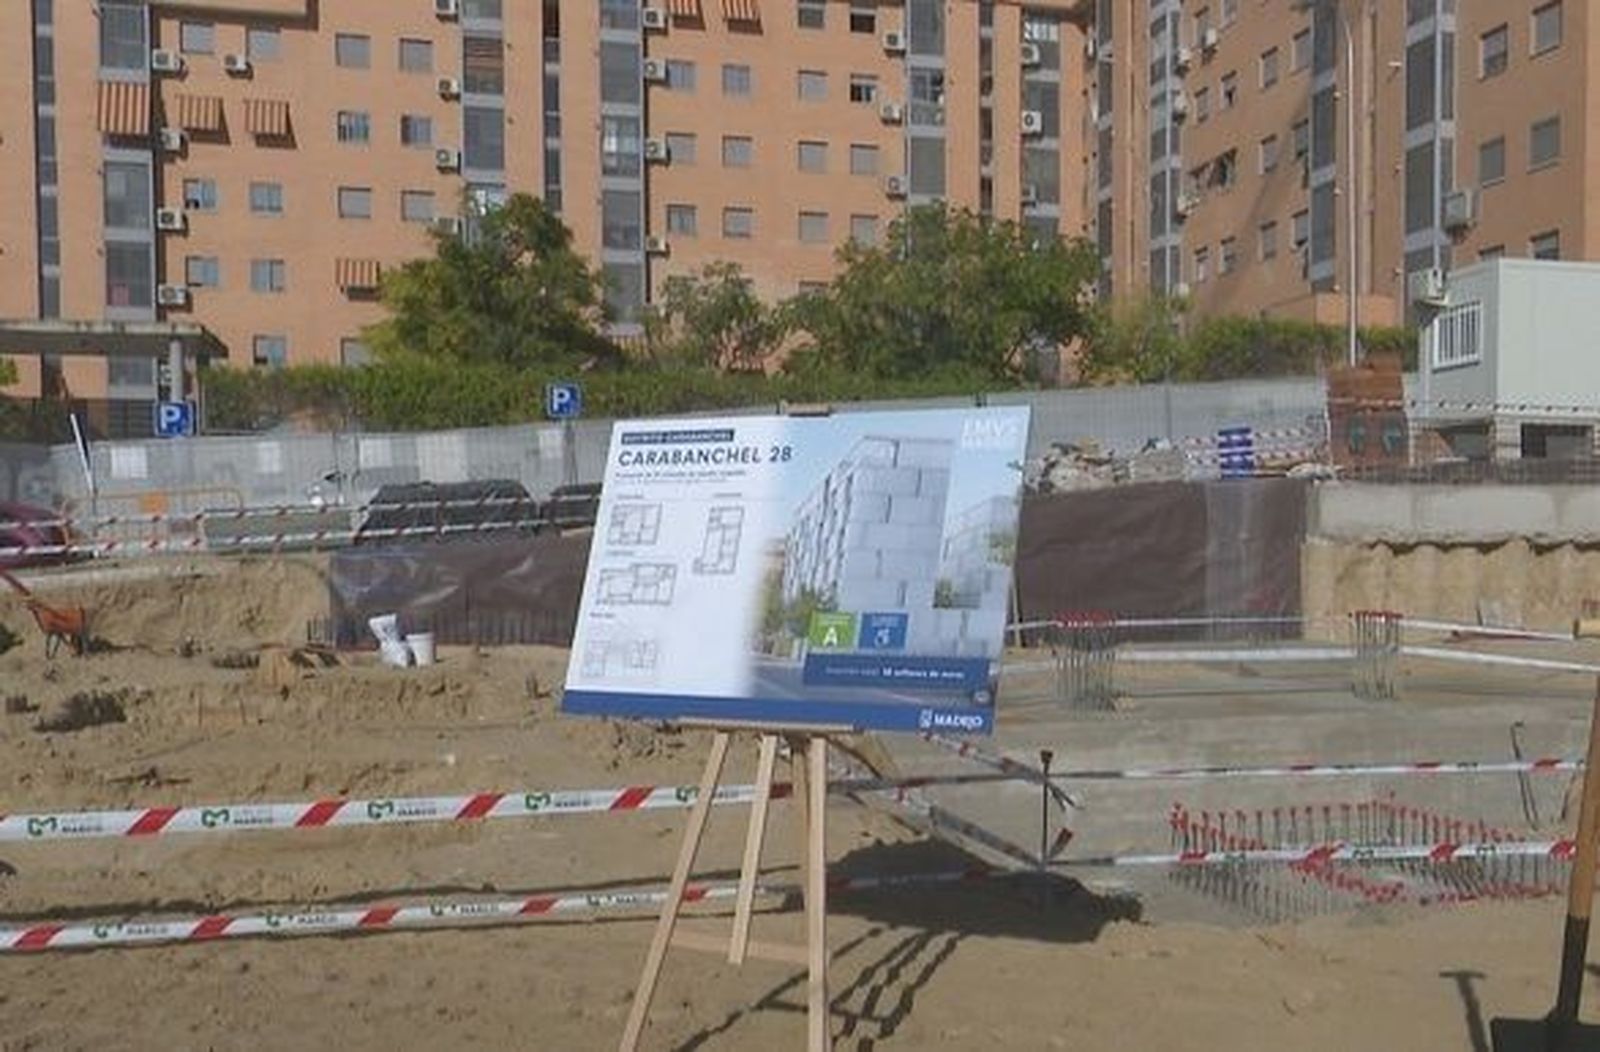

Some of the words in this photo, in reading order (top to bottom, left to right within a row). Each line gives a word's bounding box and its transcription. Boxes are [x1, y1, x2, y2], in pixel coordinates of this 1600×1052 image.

[553, 388, 570, 411] P
[161, 404, 181, 430] P
[618, 447, 763, 467] CARABANCHEL
[769, 446, 793, 463] 28
[822, 626, 838, 646] A
